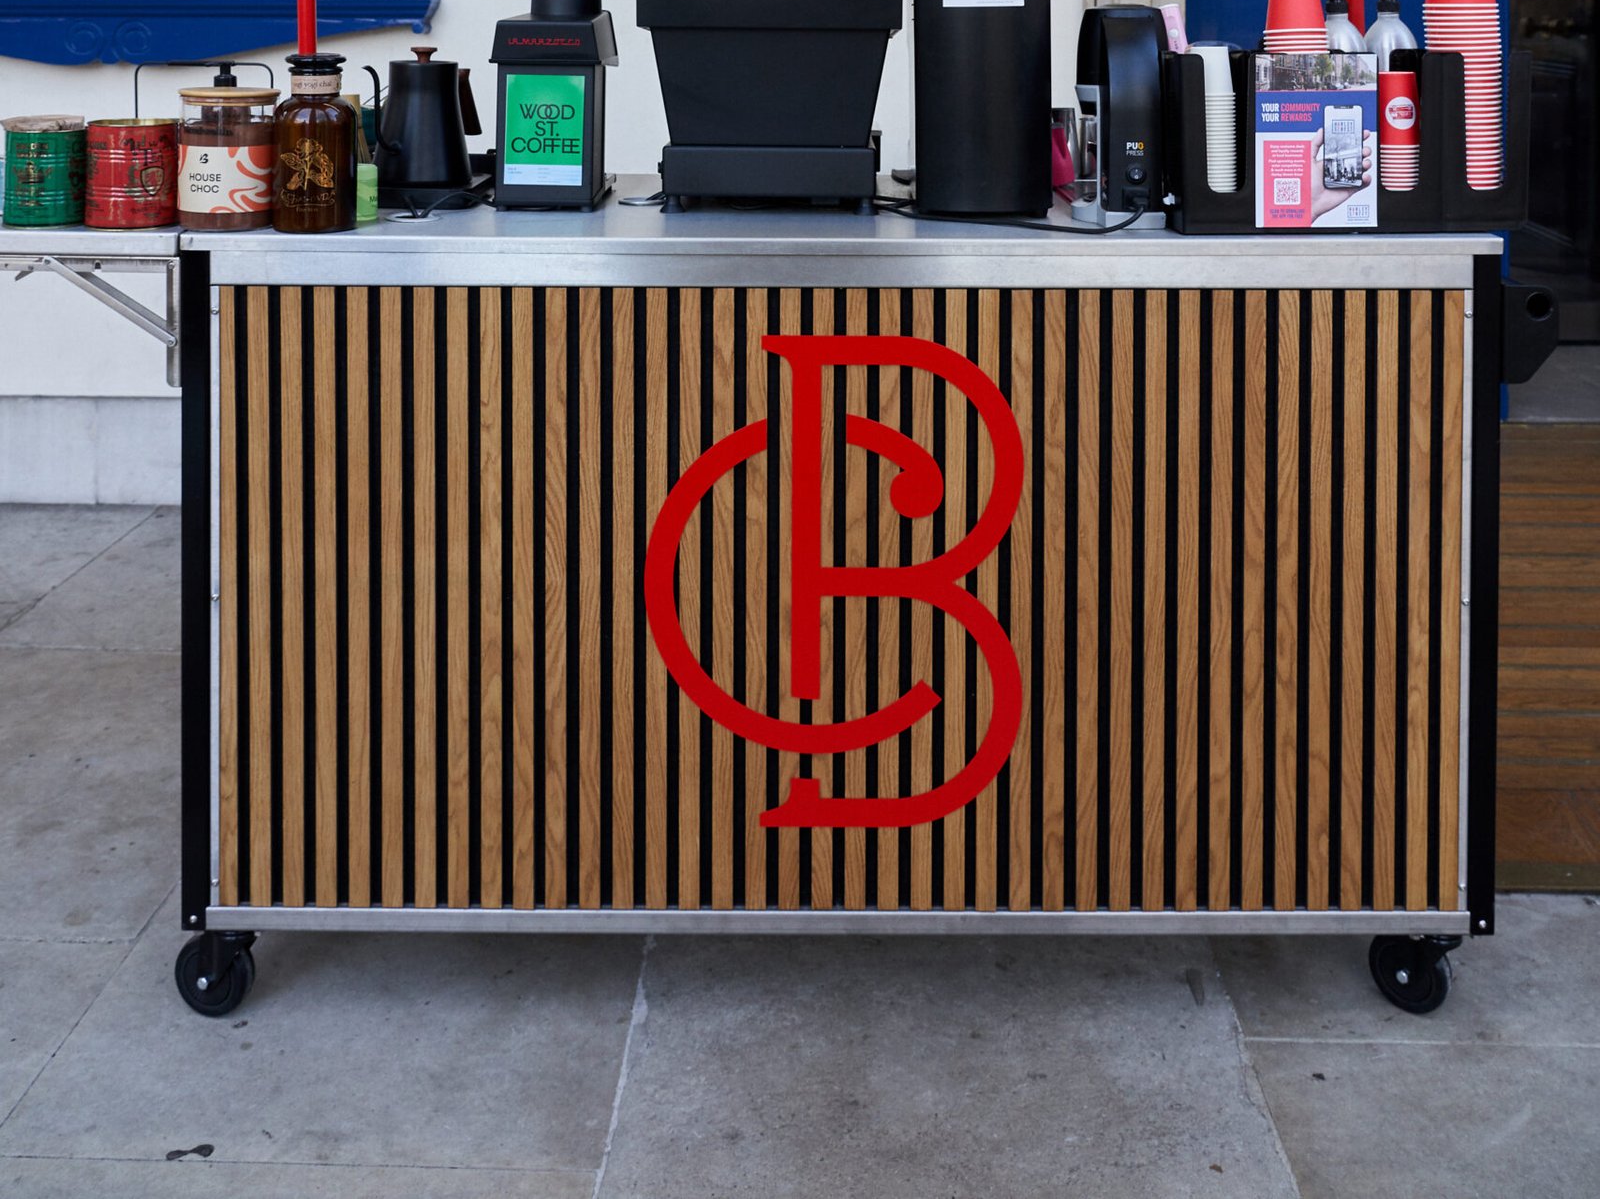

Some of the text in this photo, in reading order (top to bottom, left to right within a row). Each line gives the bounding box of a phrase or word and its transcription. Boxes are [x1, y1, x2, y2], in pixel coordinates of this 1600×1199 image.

[519, 103, 575, 120] WOOD
[1261, 103, 1321, 112] YOUR COMMUNITY
[1261, 113, 1312, 122] YOUR REWARDS
[534, 121, 559, 137] ST.
[511, 137, 580, 154] COFFEE
[189, 173, 222, 182] HOUSE
[190, 184, 220, 193] CHOC
